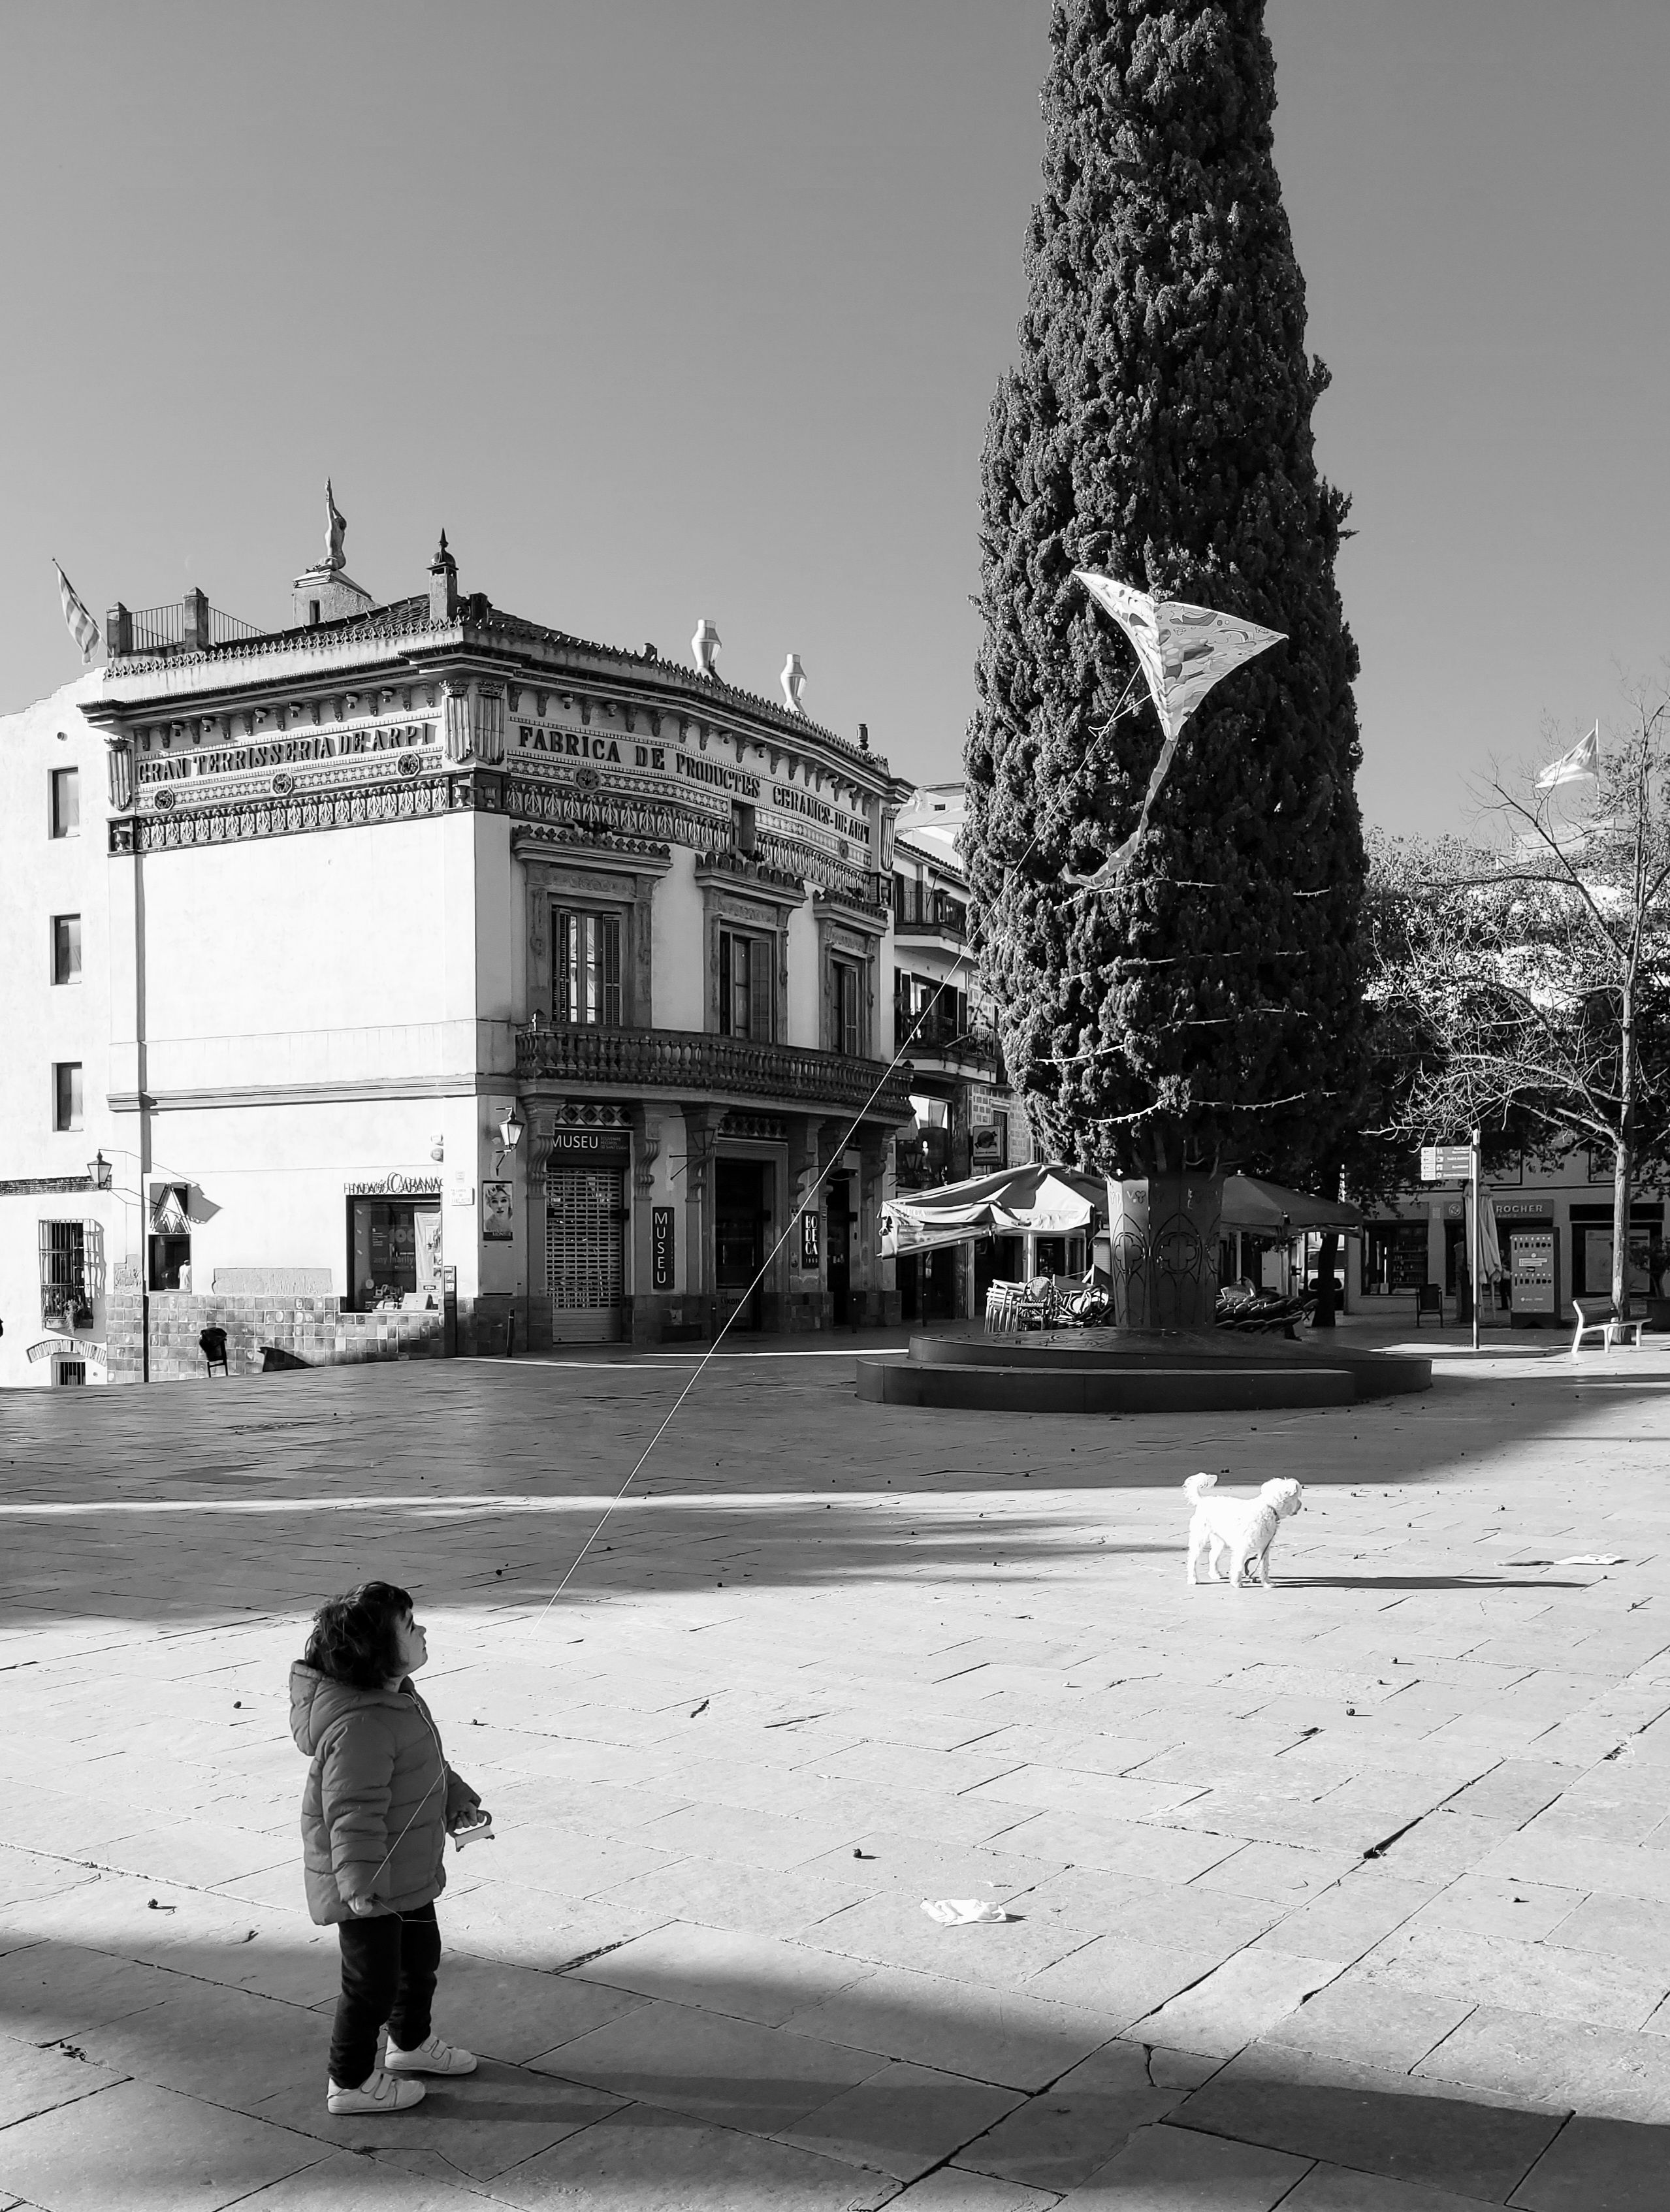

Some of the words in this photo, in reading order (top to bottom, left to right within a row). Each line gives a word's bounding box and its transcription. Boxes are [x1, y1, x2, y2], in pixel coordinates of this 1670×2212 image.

[137, 757, 187, 784] GRAN
[193, 737, 334, 775] TERRISSERIA
[338, 731, 366, 756] DE
[371, 722, 429, 751] ARPI
[519, 726, 621, 763] FABRICA
[635, 745, 665, 770] DE
[676, 753, 760, 798] PRODUCTES
[552, 1135, 598, 1148] MUSEU
[1496, 1204, 1543, 1213] ROCHER
[655, 1212, 667, 1283] MUSEU
